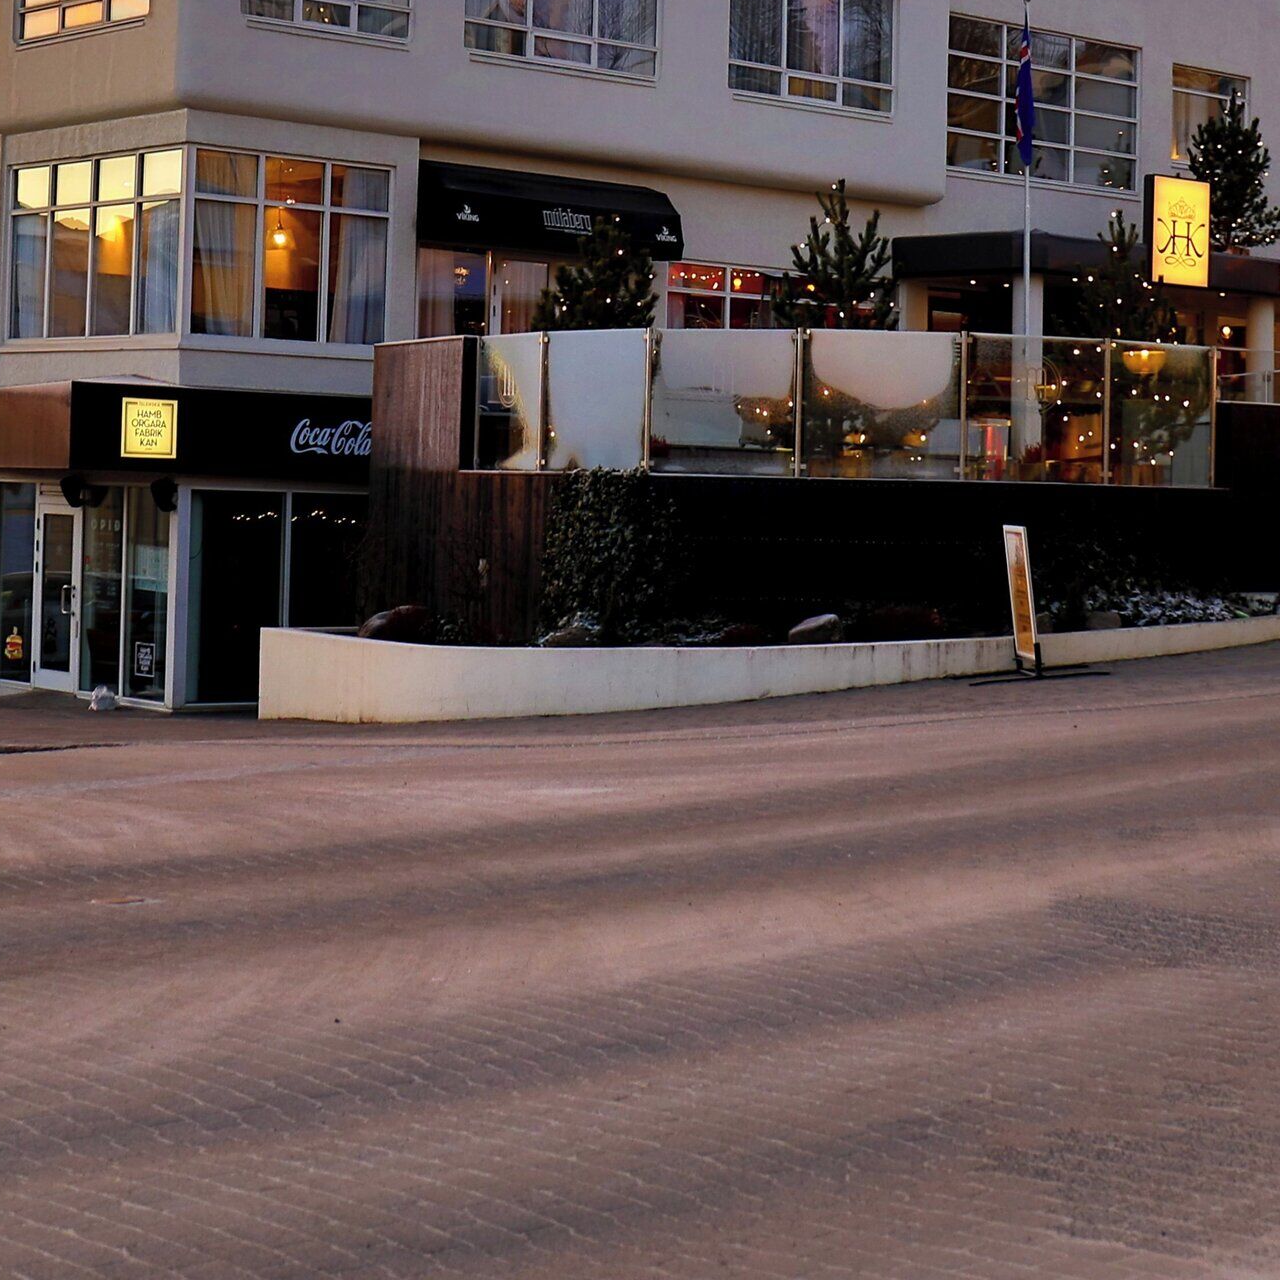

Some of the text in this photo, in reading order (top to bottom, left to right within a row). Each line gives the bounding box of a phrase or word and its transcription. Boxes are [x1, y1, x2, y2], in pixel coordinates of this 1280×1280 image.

[137, 409, 162, 419] HAMB
[131, 418, 167, 429] ORGARA
[290, 418, 372, 456] Coca-Cola
